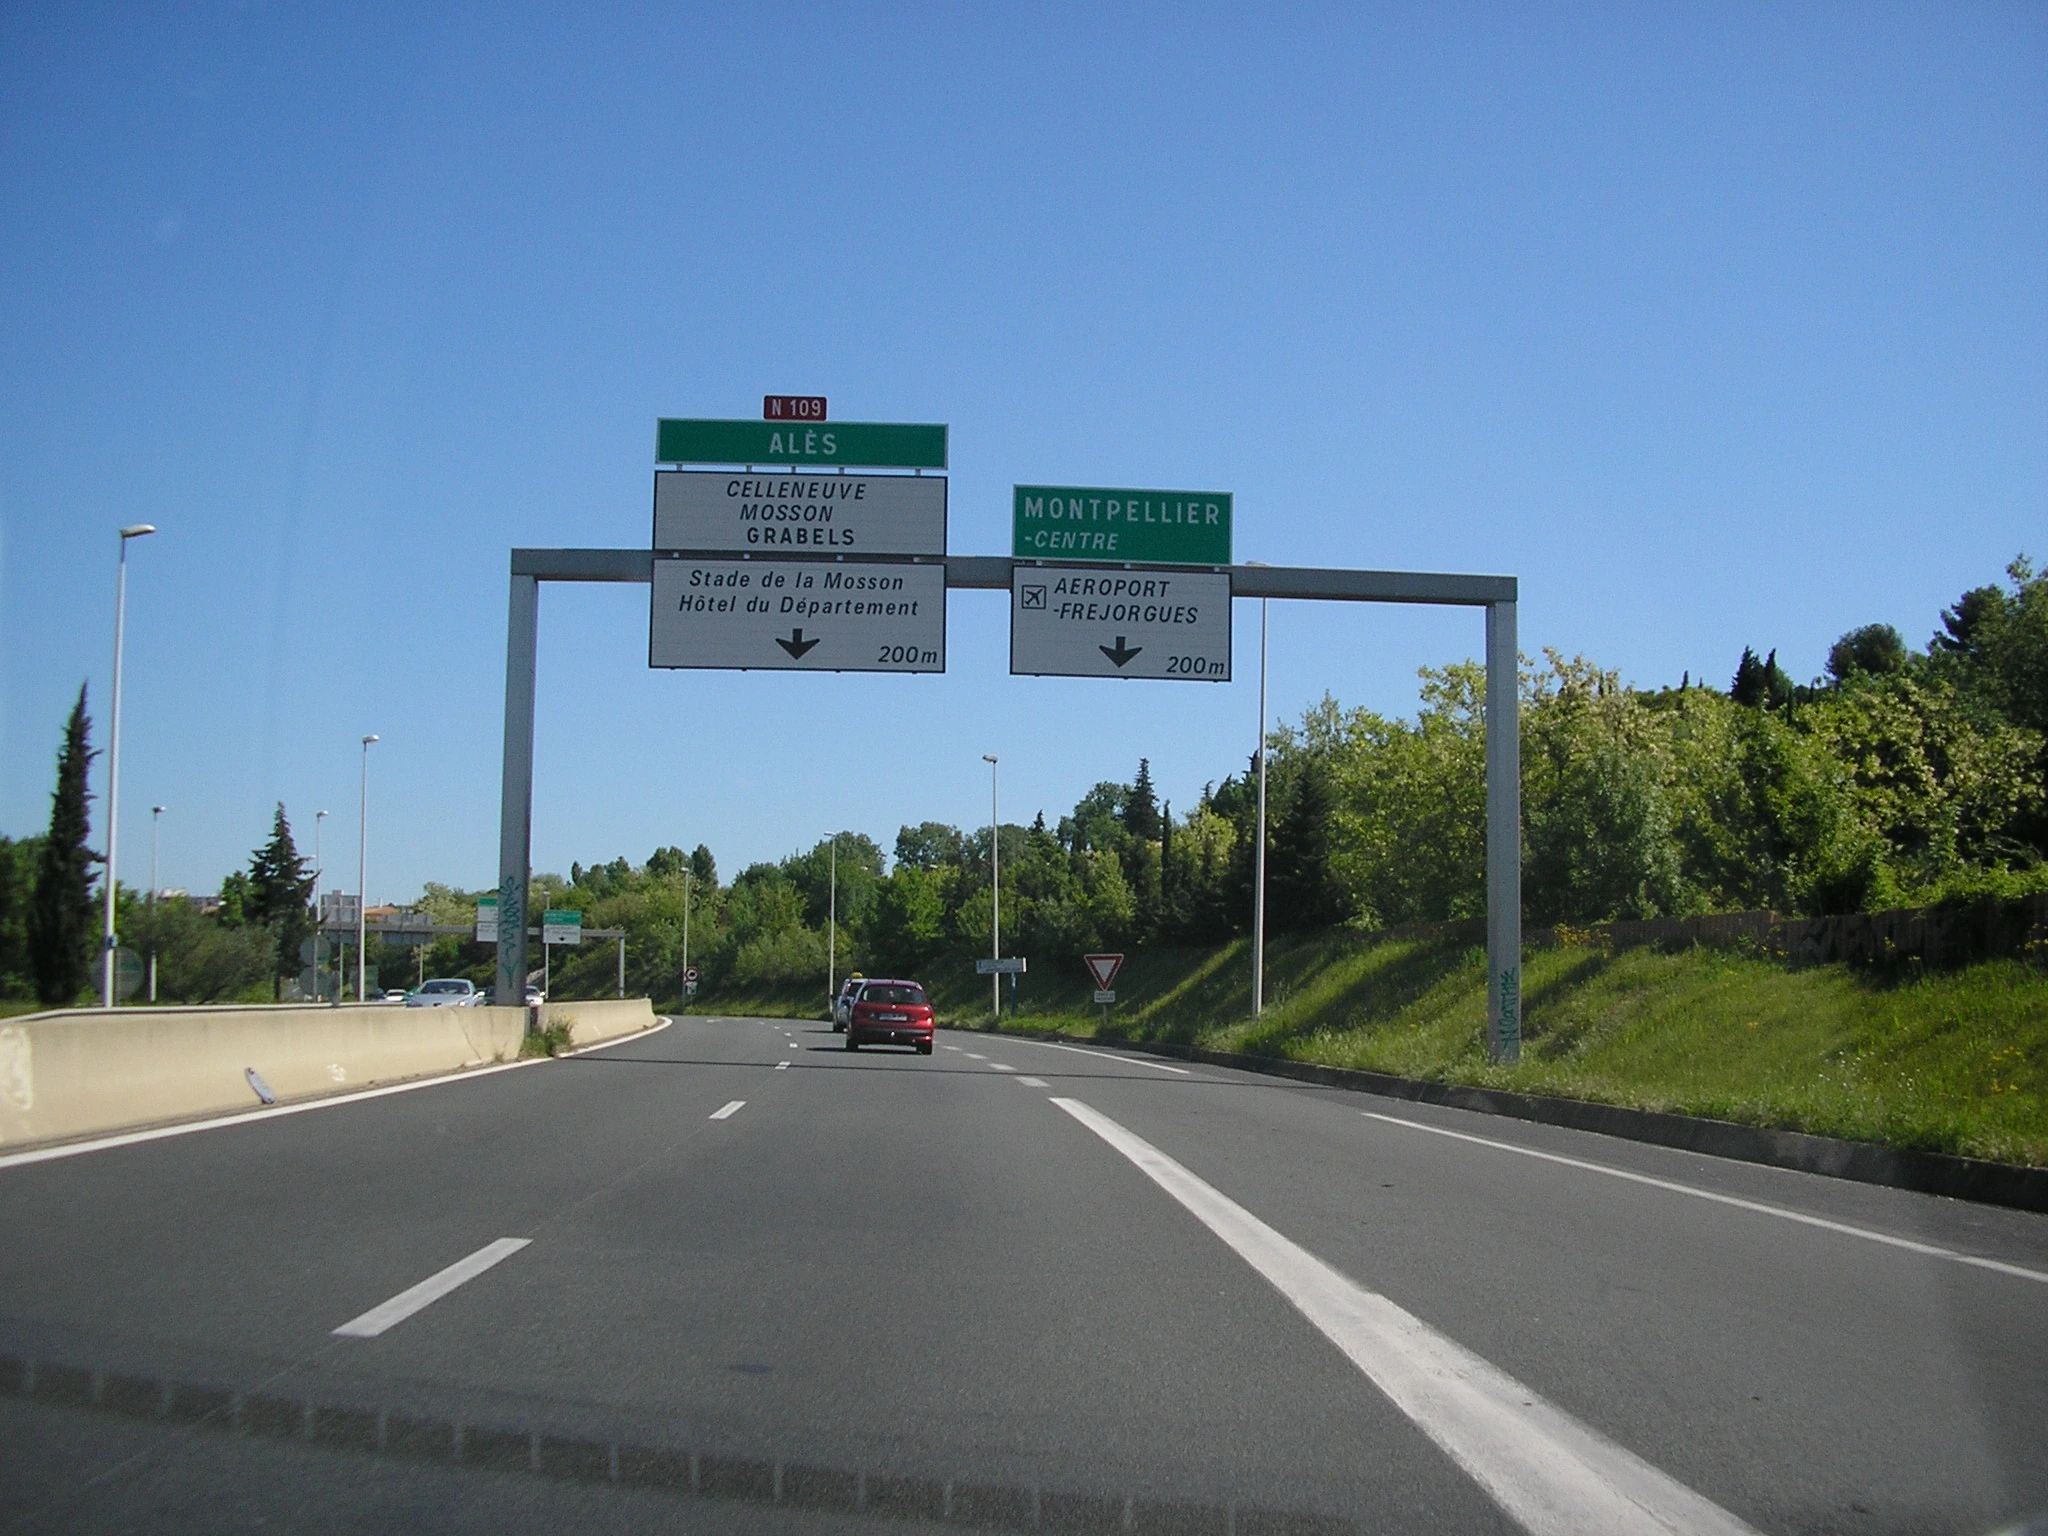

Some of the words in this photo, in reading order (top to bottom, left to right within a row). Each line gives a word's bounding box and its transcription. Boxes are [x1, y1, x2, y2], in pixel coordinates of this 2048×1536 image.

[771, 399, 782, 416] N
[789, 399, 822, 417] 109
[769, 428, 838, 456] ALÈS
[726, 480, 867, 500] CELLENEUVE
[740, 504, 834, 522] MOSSON
[1024, 496, 1220, 525] MONTPELLIER
[747, 527, 855, 546] GRABELS
[689, 570, 750, 588] Stade
[761, 571, 785, 588] de
[795, 571, 814, 589] la
[823, 572, 904, 590] Mosson
[1054, 577, 1171, 598] AEROPORT
[679, 595, 736, 613] Hôtel
[746, 596, 770, 614] du
[779, 597, 919, 618] Département
